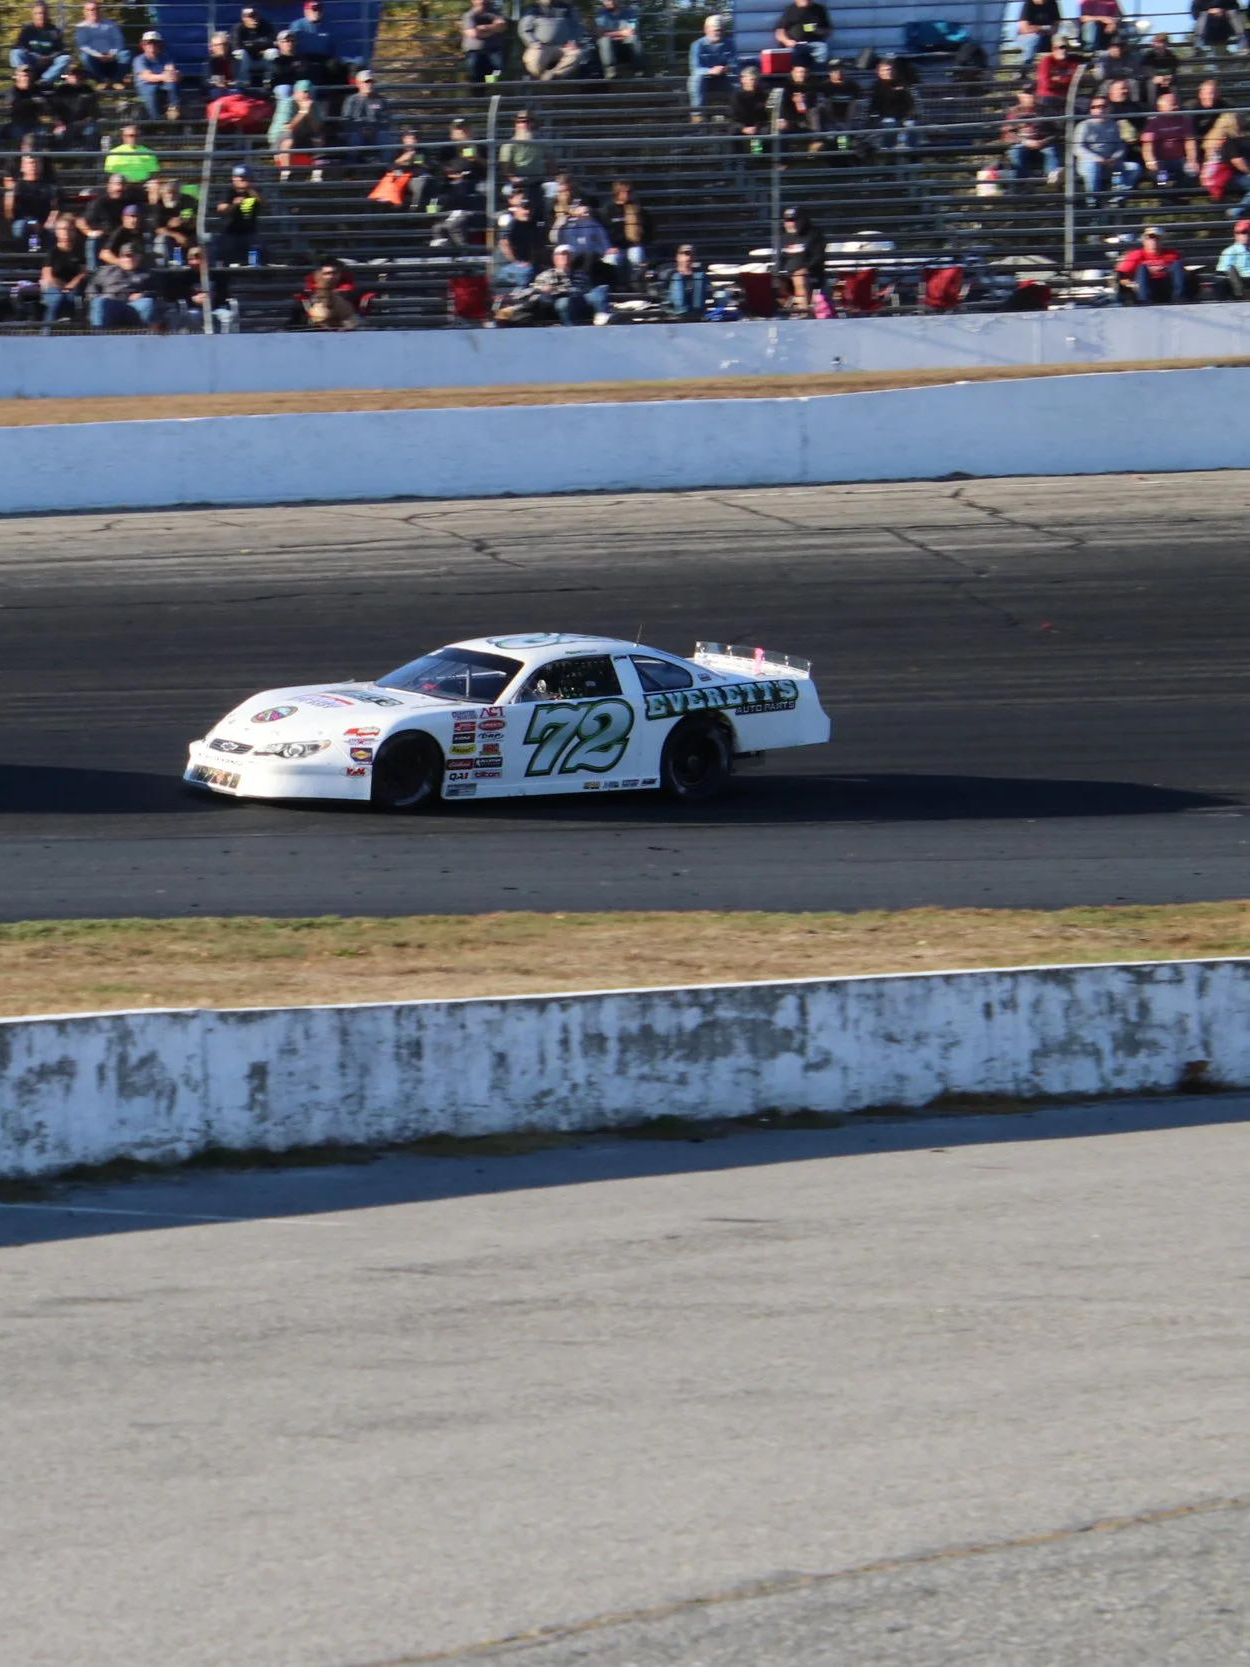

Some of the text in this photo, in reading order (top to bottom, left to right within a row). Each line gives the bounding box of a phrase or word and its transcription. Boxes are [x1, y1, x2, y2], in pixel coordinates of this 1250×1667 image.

[480, 706, 506, 719] ACT
[645, 679, 799, 719] EVERETT'S
[736, 701, 795, 715] AUTO PARTS
[523, 697, 635, 778] 72
